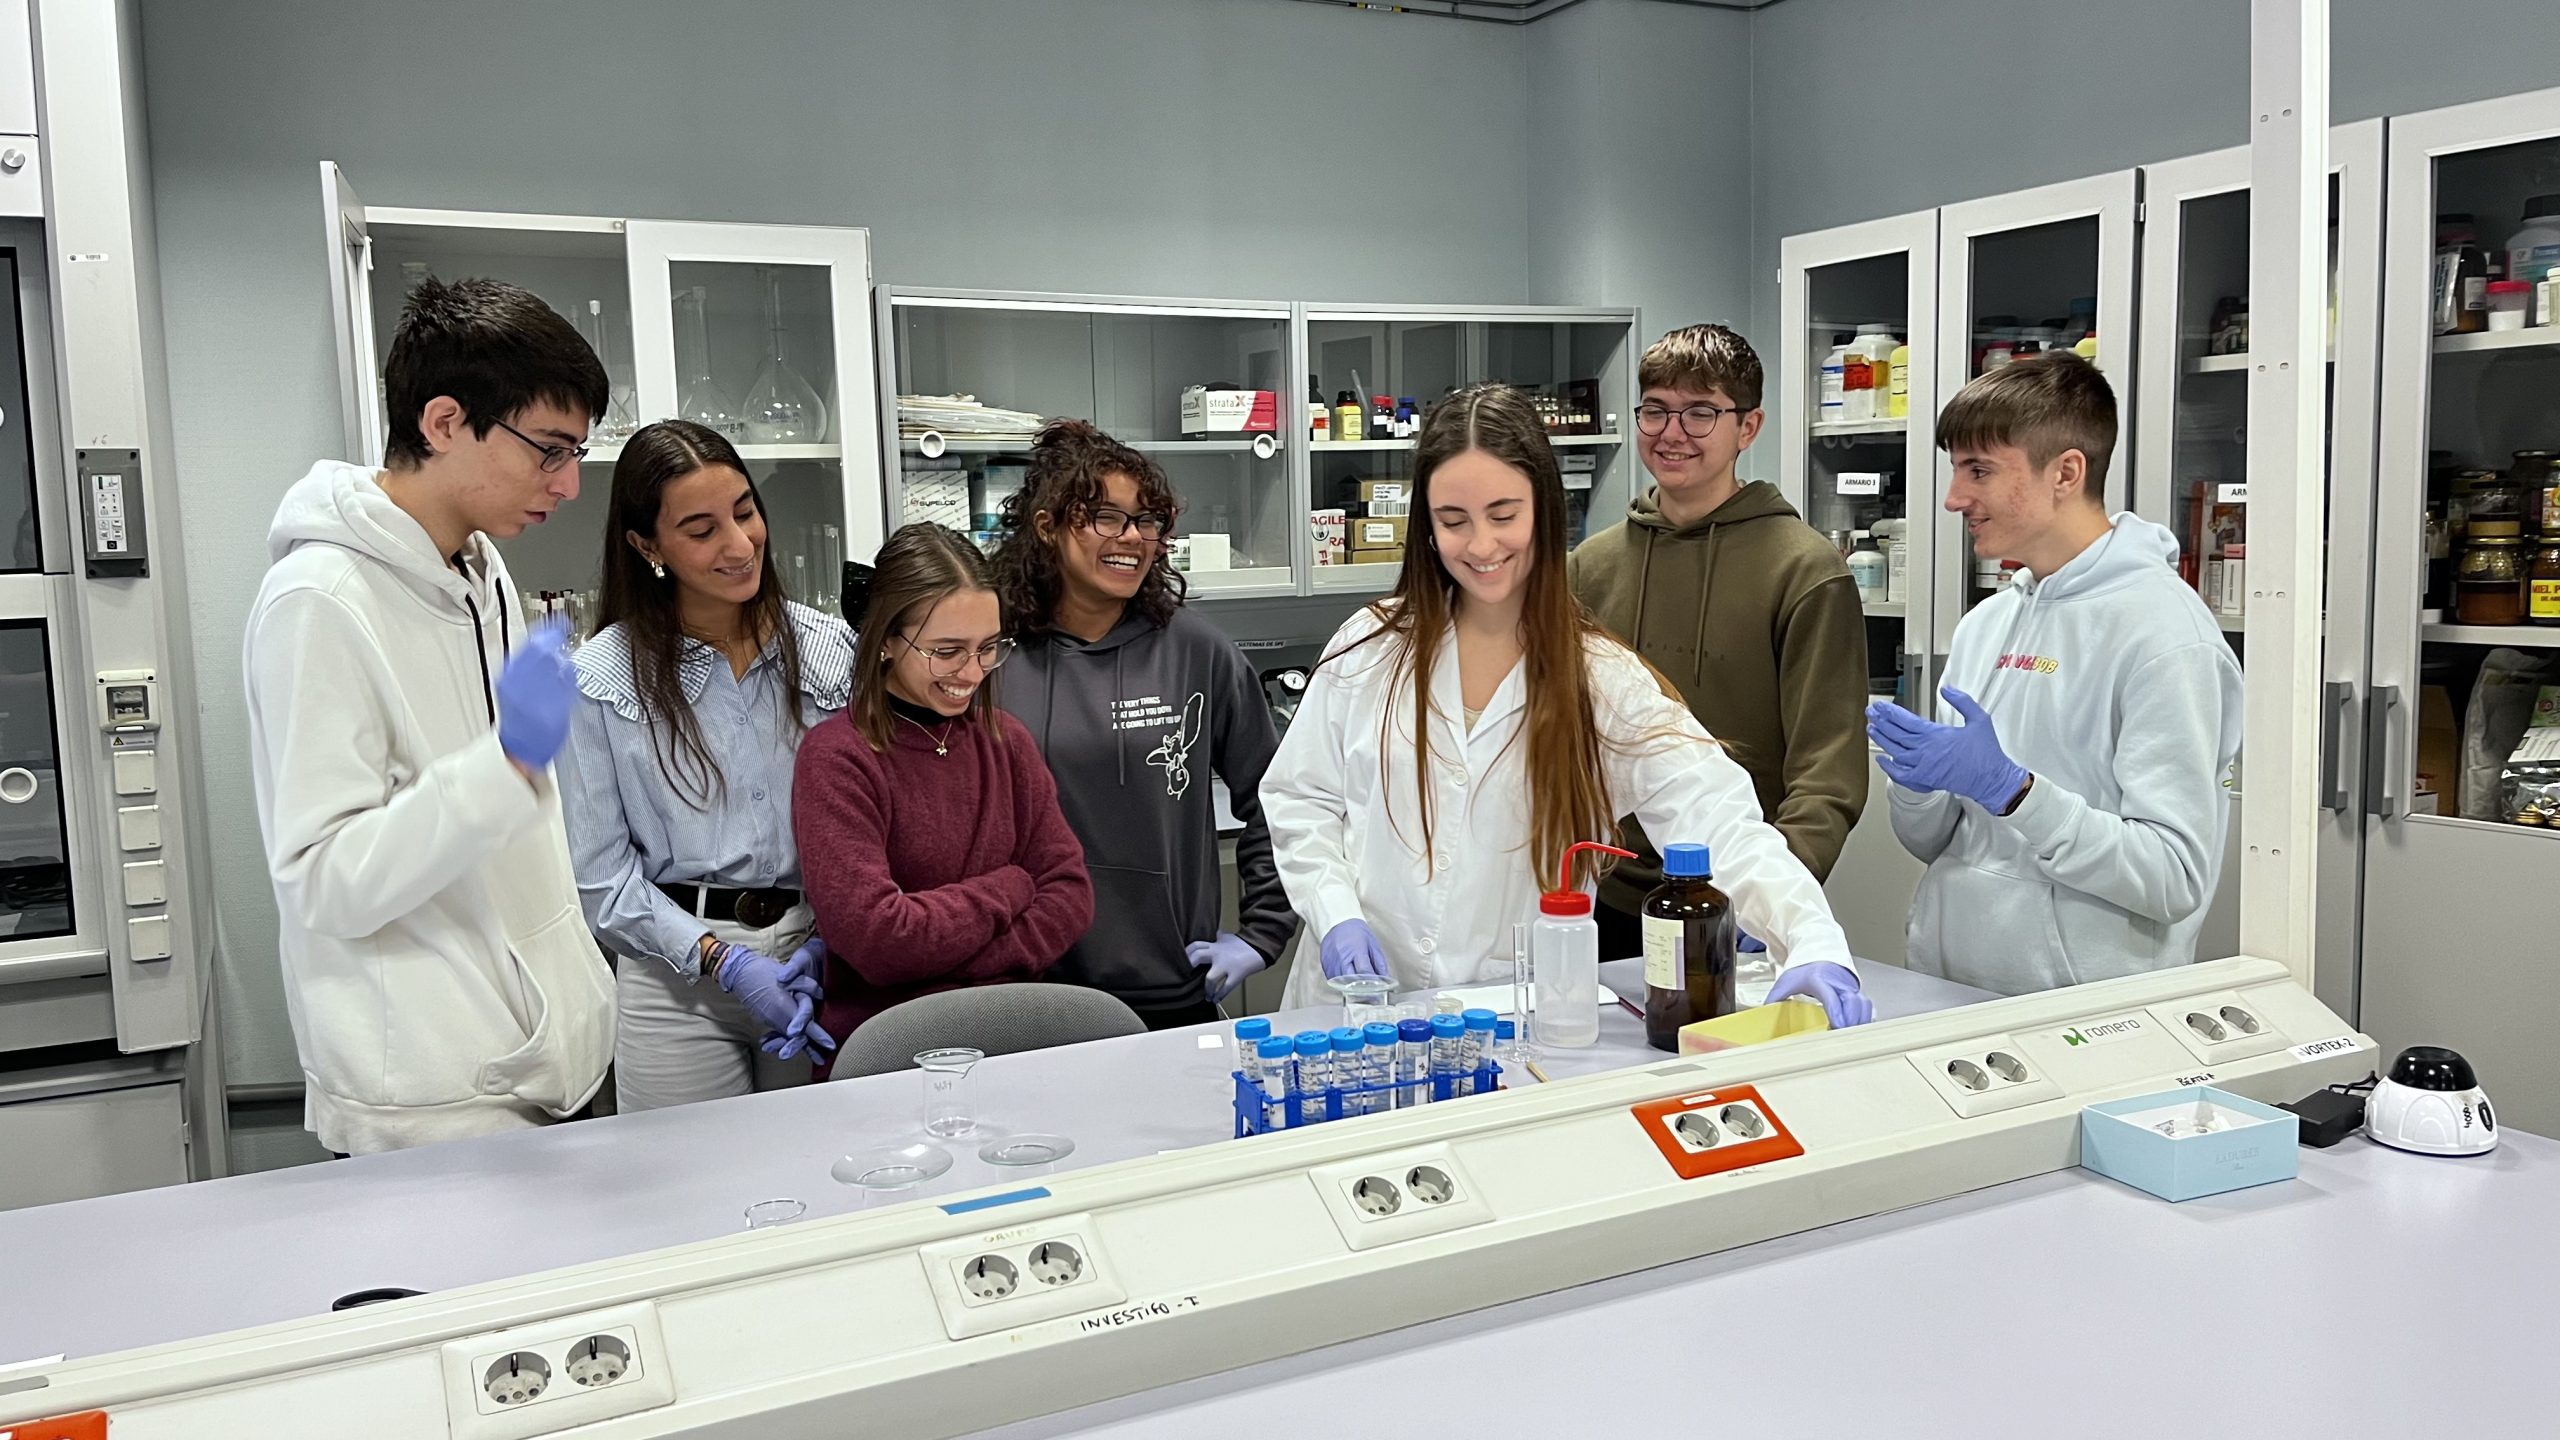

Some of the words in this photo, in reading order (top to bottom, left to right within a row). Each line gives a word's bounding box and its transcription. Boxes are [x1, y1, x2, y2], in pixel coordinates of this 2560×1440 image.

[919, 499, 956, 507] SUPELCO
[2533, 584, 2552, 594] MIEL
[1112, 710, 1127, 720] TAT
[1128, 708, 1145, 718] HOLD
[1145, 707, 1157, 716] YOU
[1157, 705, 1172, 715] DOWN
[1153, 717, 1165, 726] LIFT
[2084, 1019, 2141, 1039] romero
[2299, 1037, 2356, 1056] VORTEX-2
[1080, 1301, 1170, 1332] INVESTIGO
